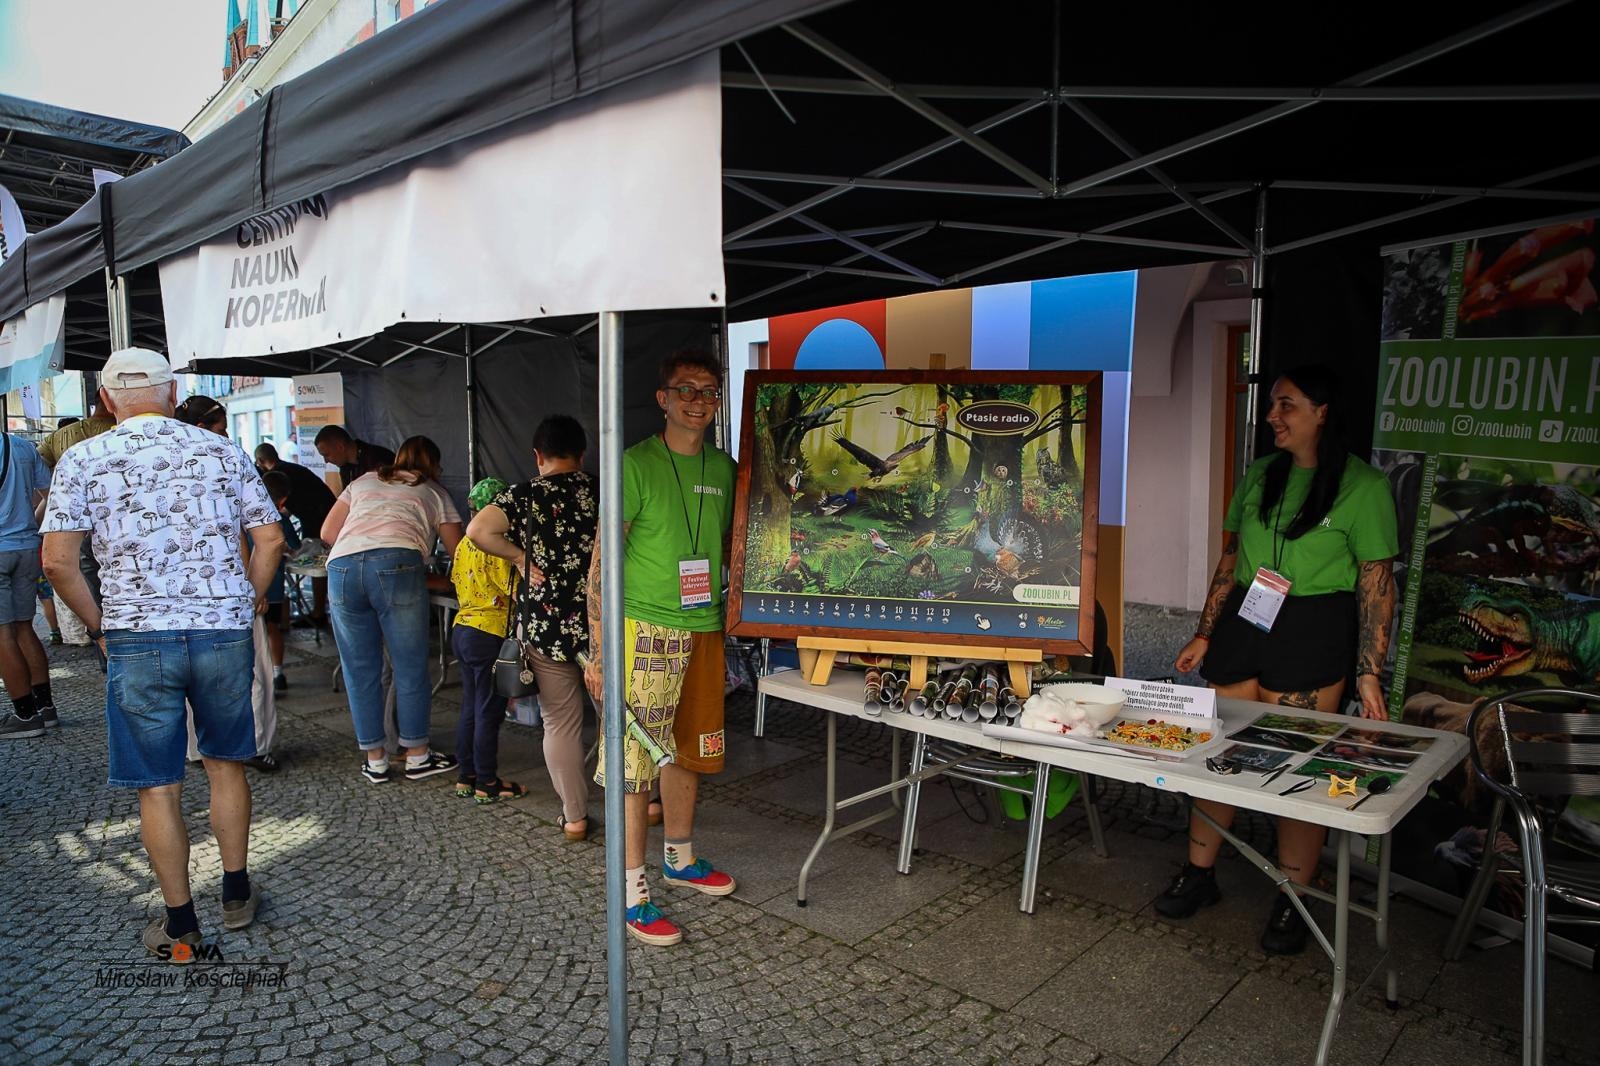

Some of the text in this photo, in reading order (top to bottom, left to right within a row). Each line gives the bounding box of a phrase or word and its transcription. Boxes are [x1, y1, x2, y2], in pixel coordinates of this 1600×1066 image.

[230, 245, 300, 289] NAUKI
[224, 275, 327, 329] KOPERNIK
[966, 413, 1030, 423] Ptasie radio
[1401, 581, 1420, 633] ZOOLUBIN.PL
[1411, 518, 1428, 572] ZOOLUBIN.PL
[1420, 453, 1438, 508] ZOOLUBIN.PL
[760, 599, 950, 617] 1 2 3 4 5 6 7 8 9 10 11 12 13
[1022, 588, 1072, 600] ZOOLUBIN.PL
